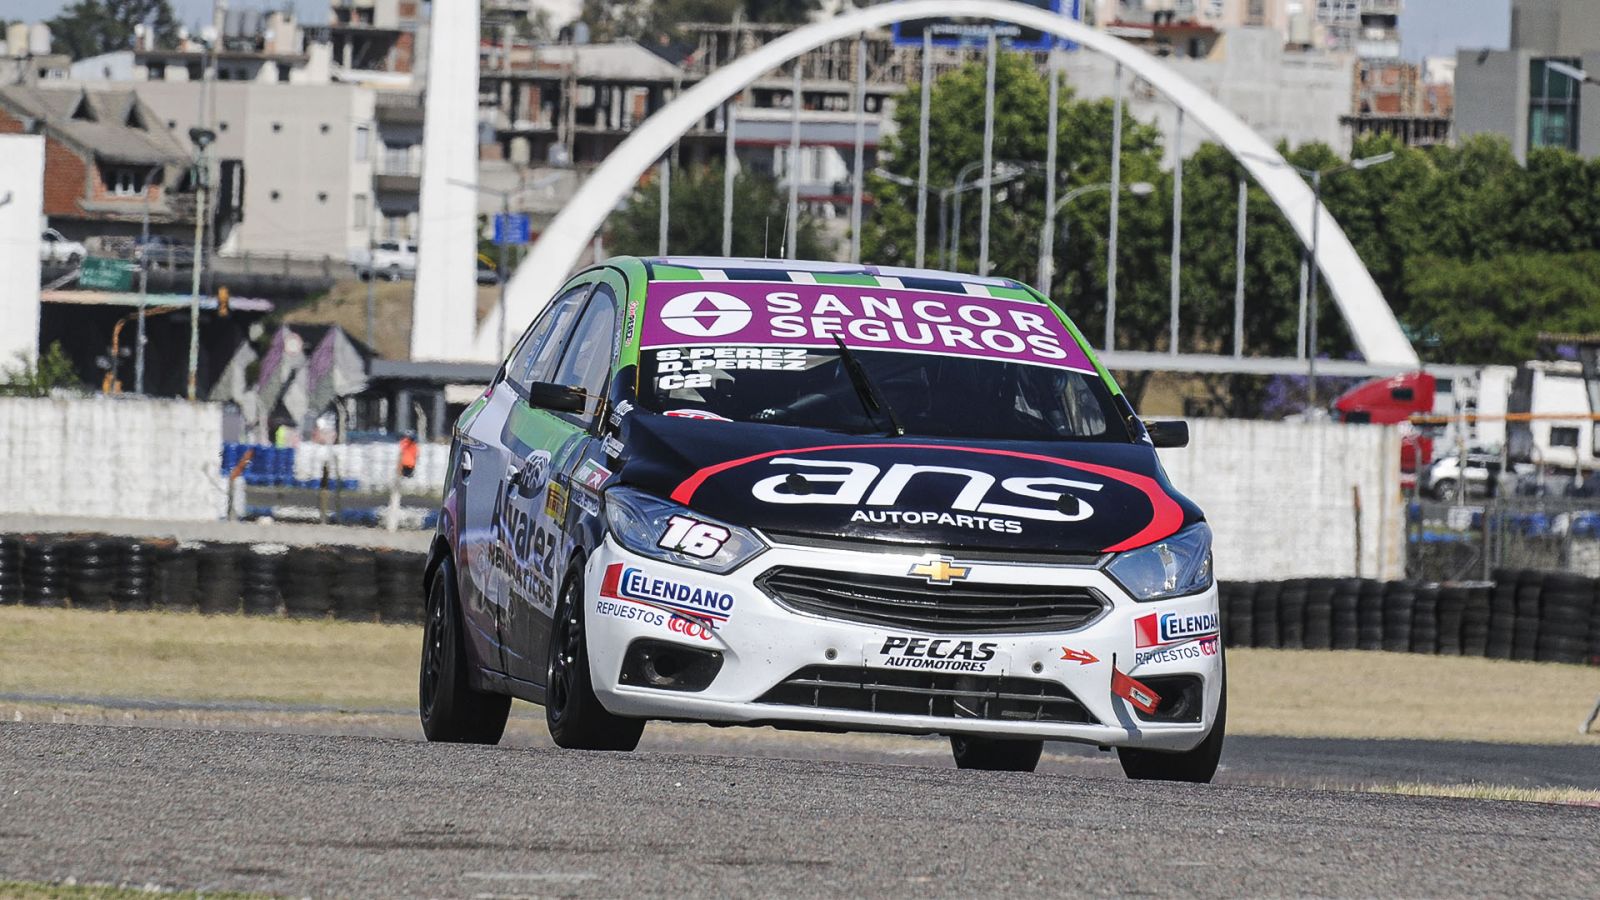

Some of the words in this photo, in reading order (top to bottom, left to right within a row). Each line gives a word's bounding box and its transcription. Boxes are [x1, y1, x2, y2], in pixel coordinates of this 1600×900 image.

[766, 292, 1058, 337] SANCOR
[769, 314, 1068, 360] SEGUROS
[656, 347, 808, 361] S.PEREZ
[657, 359, 807, 373] D.PEREZ
[658, 373, 712, 390] C2
[752, 457, 1104, 522] ans
[490, 480, 557, 580] Alvarez
[850, 509, 1023, 534] AUTOPARTES
[656, 514, 732, 560] 16
[620, 567, 734, 612] CELENDANO
[596, 601, 665, 627] REPUESTOS
[879, 635, 998, 662] PECAS
[884, 656, 987, 673] AUTOMOTORES
